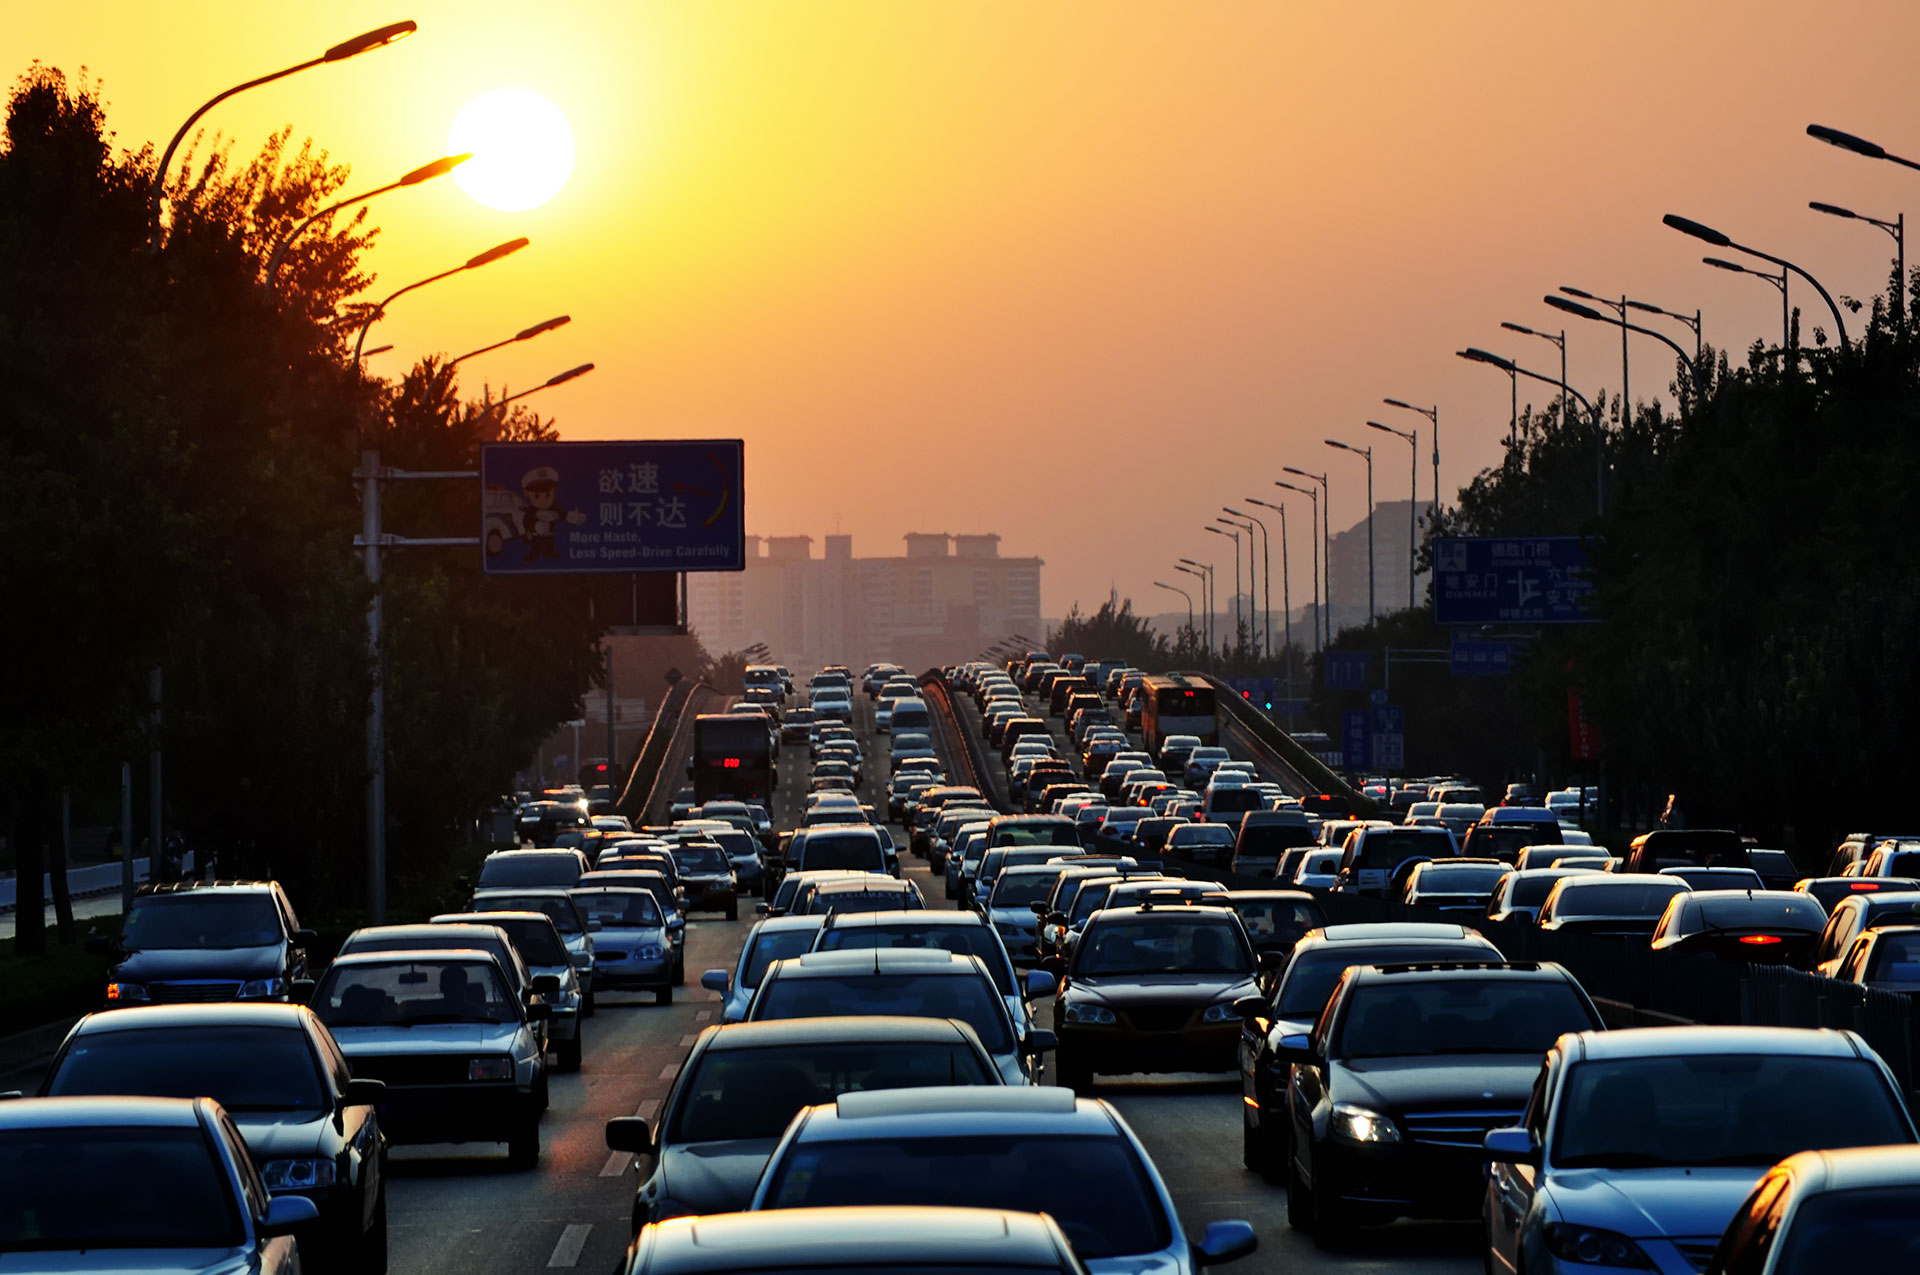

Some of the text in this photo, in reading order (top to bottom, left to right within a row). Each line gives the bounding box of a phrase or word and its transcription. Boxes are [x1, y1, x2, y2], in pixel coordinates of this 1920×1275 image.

[598, 461, 659, 494] 欲速
[599, 496, 687, 529] 则不达
[569, 531, 642, 543] More Haste,
[569, 544, 730, 560] Less Speed-Drive Carefully
[1445, 573, 1498, 590] 地安门
